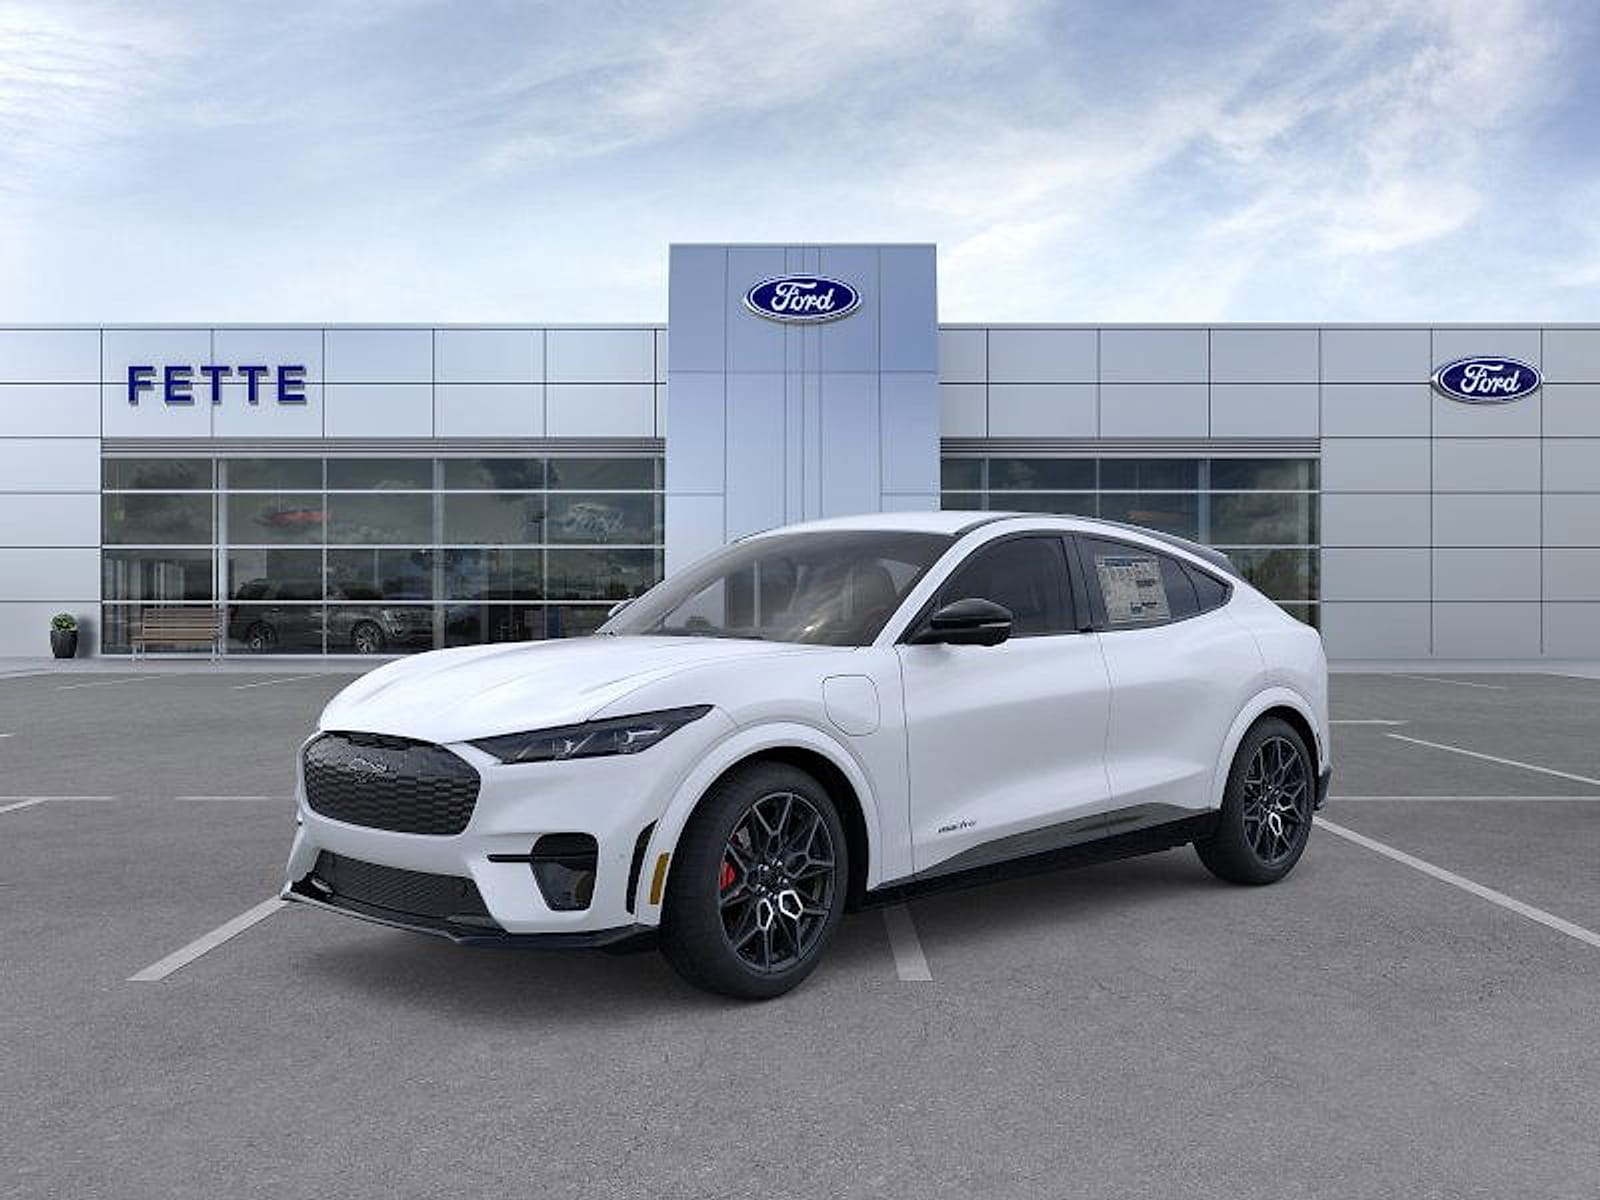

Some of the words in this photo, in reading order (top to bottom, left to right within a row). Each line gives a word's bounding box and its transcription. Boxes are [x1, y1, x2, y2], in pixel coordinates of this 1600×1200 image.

[771, 282, 835, 311] Ford
[128, 366, 306, 404] FETTE
[1460, 364, 1521, 393] Ford
